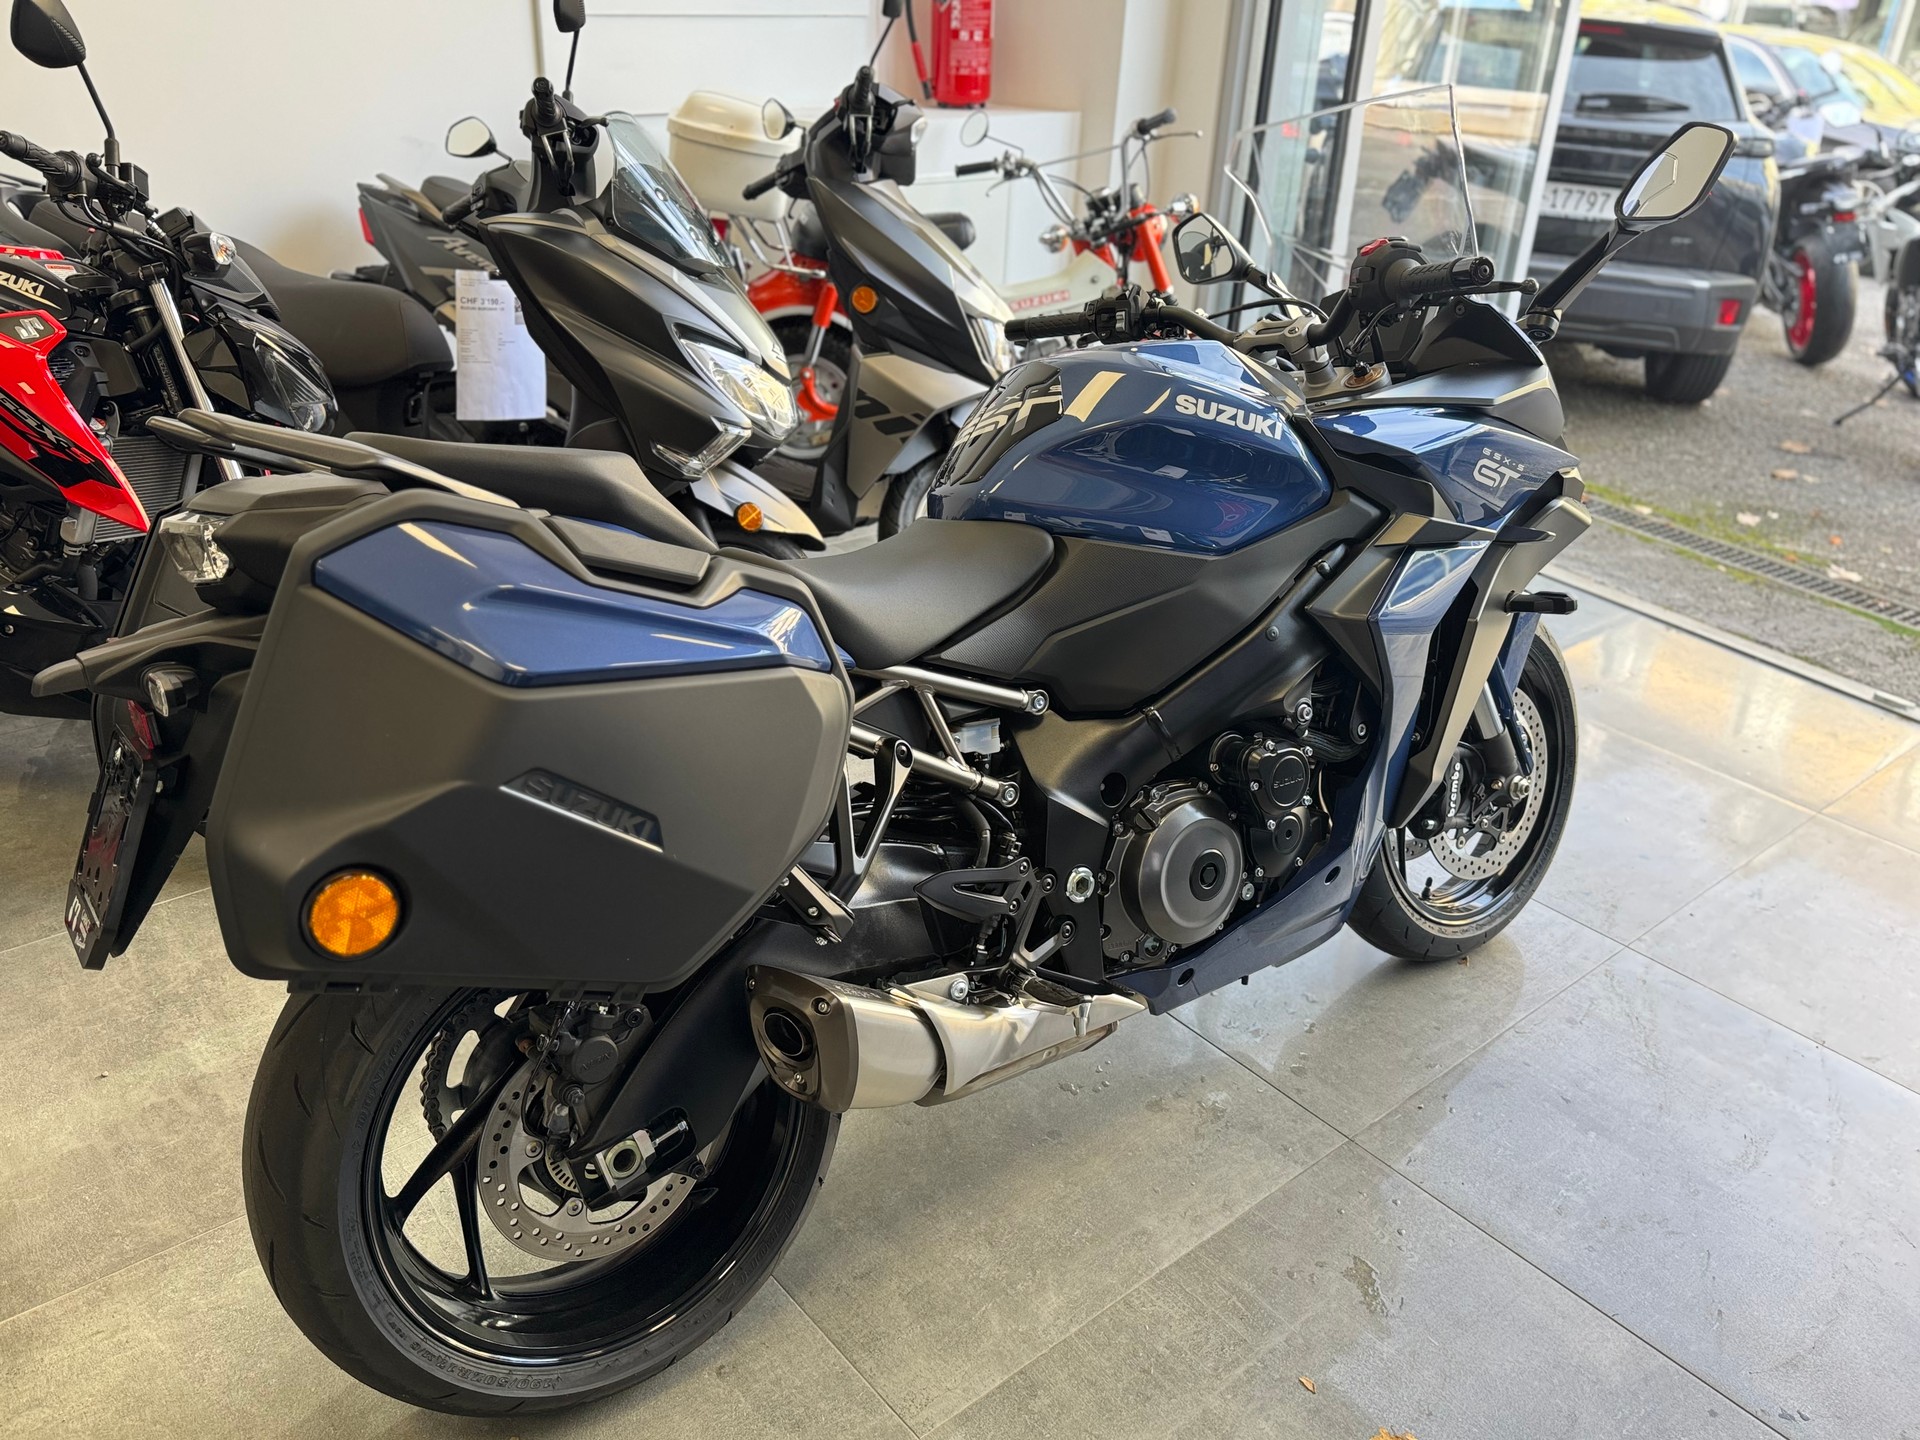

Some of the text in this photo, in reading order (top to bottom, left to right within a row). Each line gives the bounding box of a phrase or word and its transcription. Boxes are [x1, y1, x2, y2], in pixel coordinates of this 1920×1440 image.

[1009, 289, 1070, 313] SUZUKI
[1175, 394, 1282, 441] SUZUKI
[1473, 458, 1522, 488] GT
[524, 773, 656, 843] SUZUKI
[1447, 762, 1461, 818] brembo
